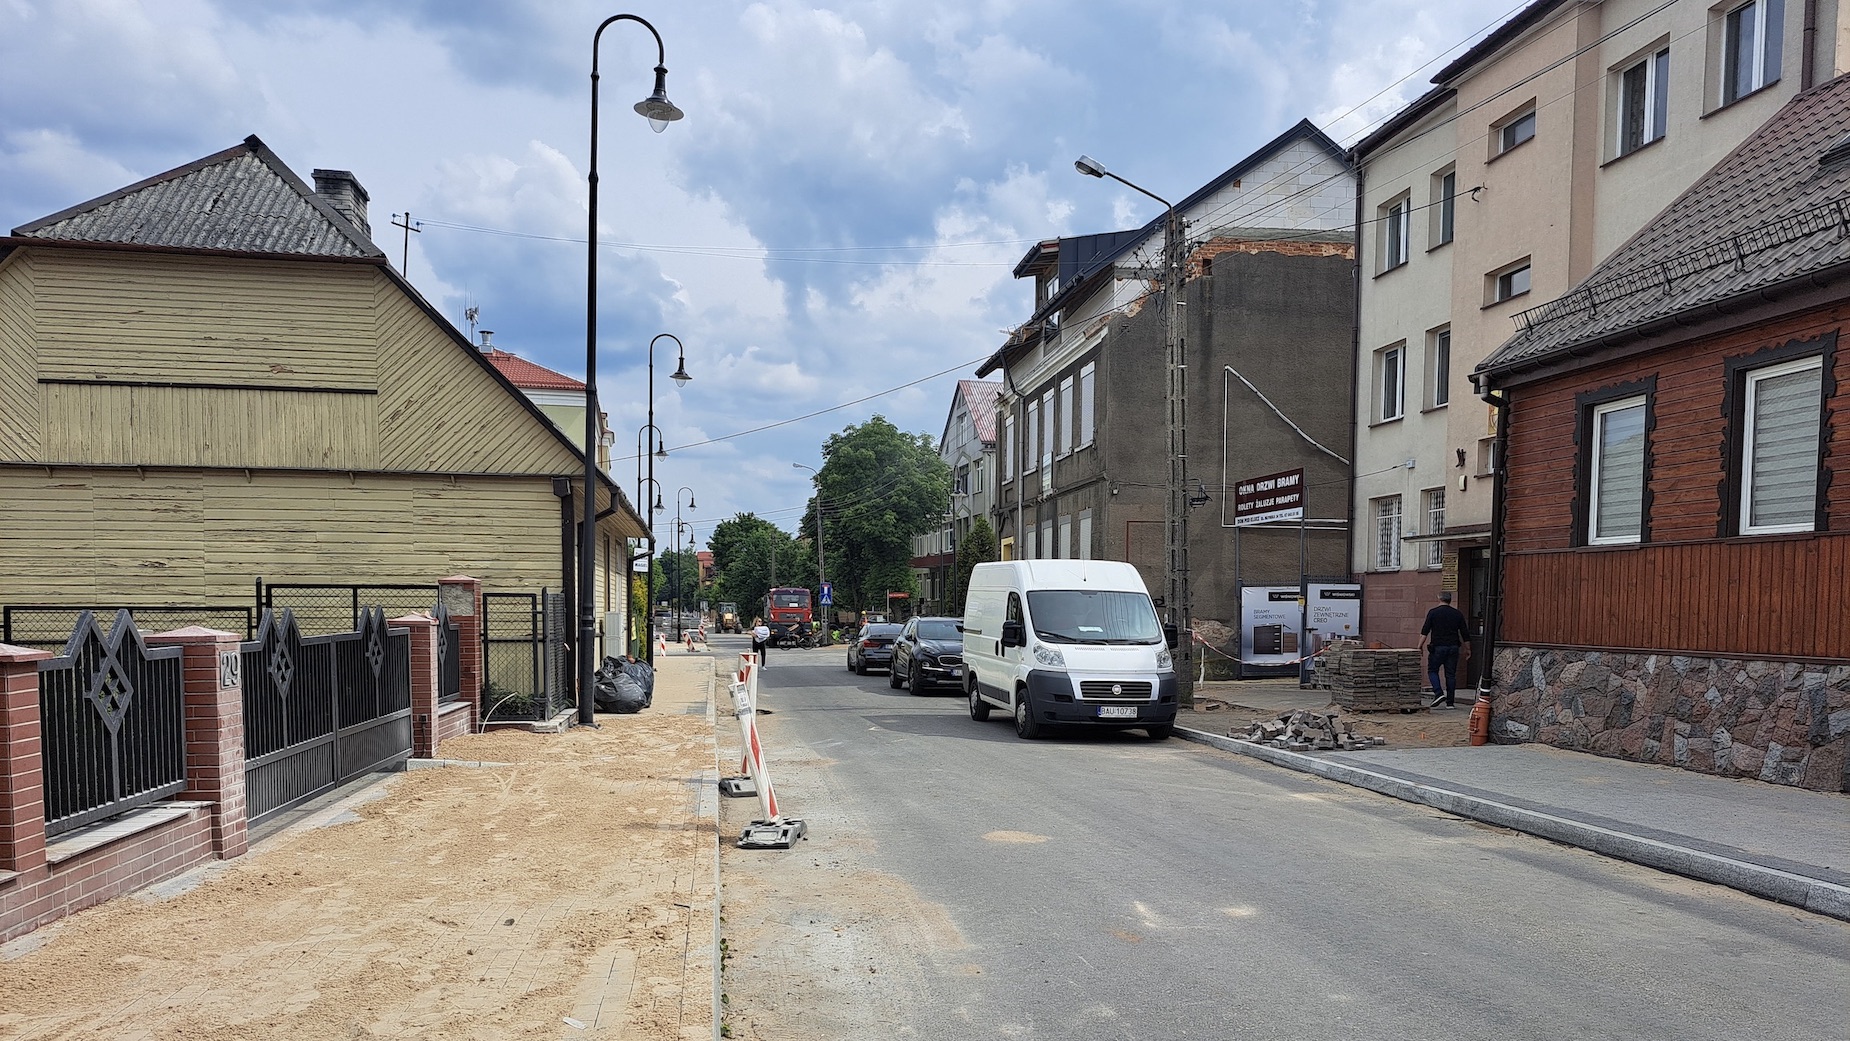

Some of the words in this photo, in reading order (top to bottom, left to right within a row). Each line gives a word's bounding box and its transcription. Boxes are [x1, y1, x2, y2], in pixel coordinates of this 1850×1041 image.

[1238, 484, 1254, 495] OKNA
[1256, 479, 1275, 491] DRZWI
[1276, 474, 1300, 488] BRAMY
[1237, 501, 1254, 511] ROLETY
[1255, 498, 1275, 508] ŻALUZJE
[1275, 493, 1300, 505] PARAPETY
[222, 652, 238, 686] 29
